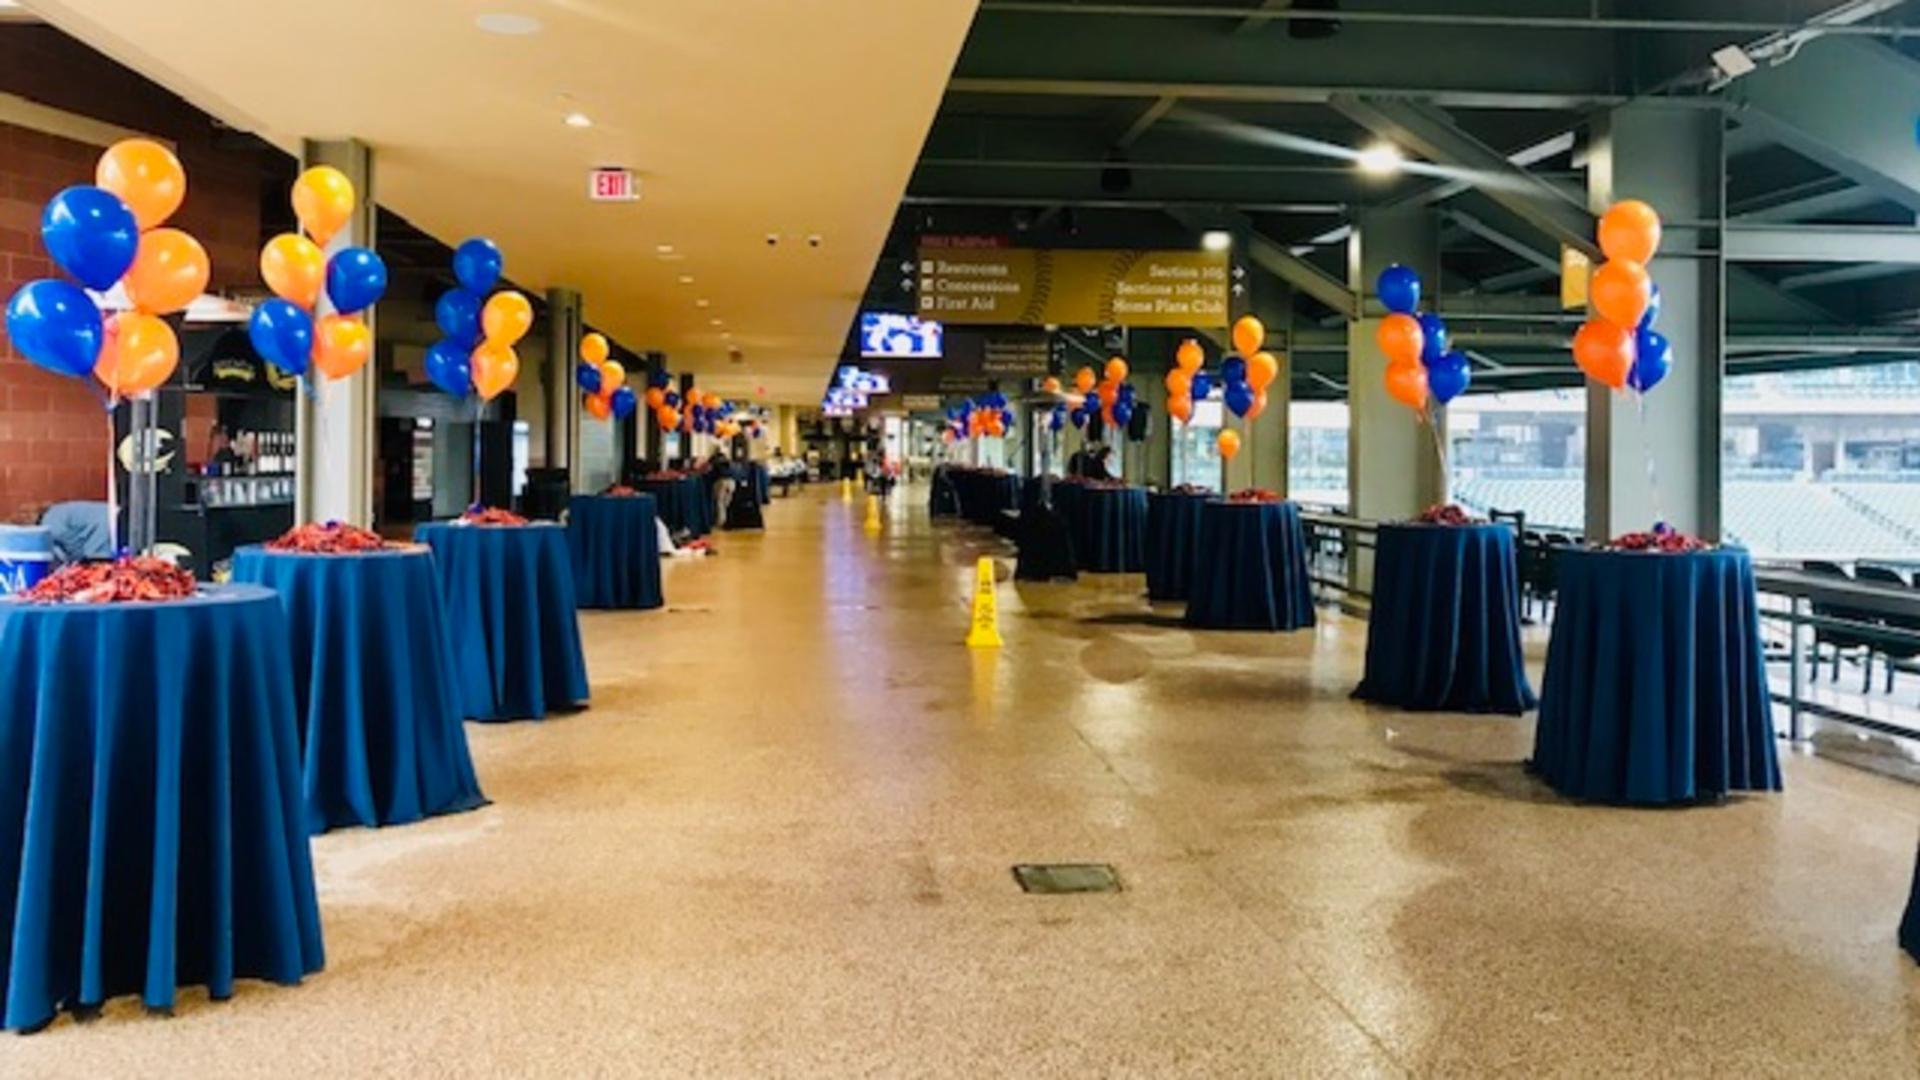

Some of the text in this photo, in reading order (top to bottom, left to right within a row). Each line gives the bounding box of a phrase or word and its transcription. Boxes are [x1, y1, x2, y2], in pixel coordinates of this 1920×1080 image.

[597, 173, 626, 196] EXIT
[936, 261, 1008, 276] Restrooms
[1149, 264, 1199, 278] Section
[936, 278, 1021, 292] Concessions
[1116, 282, 1173, 296] Sections
[936, 296, 996, 310] First Aid
[1112, 299, 1225, 313] Home Plate Club
